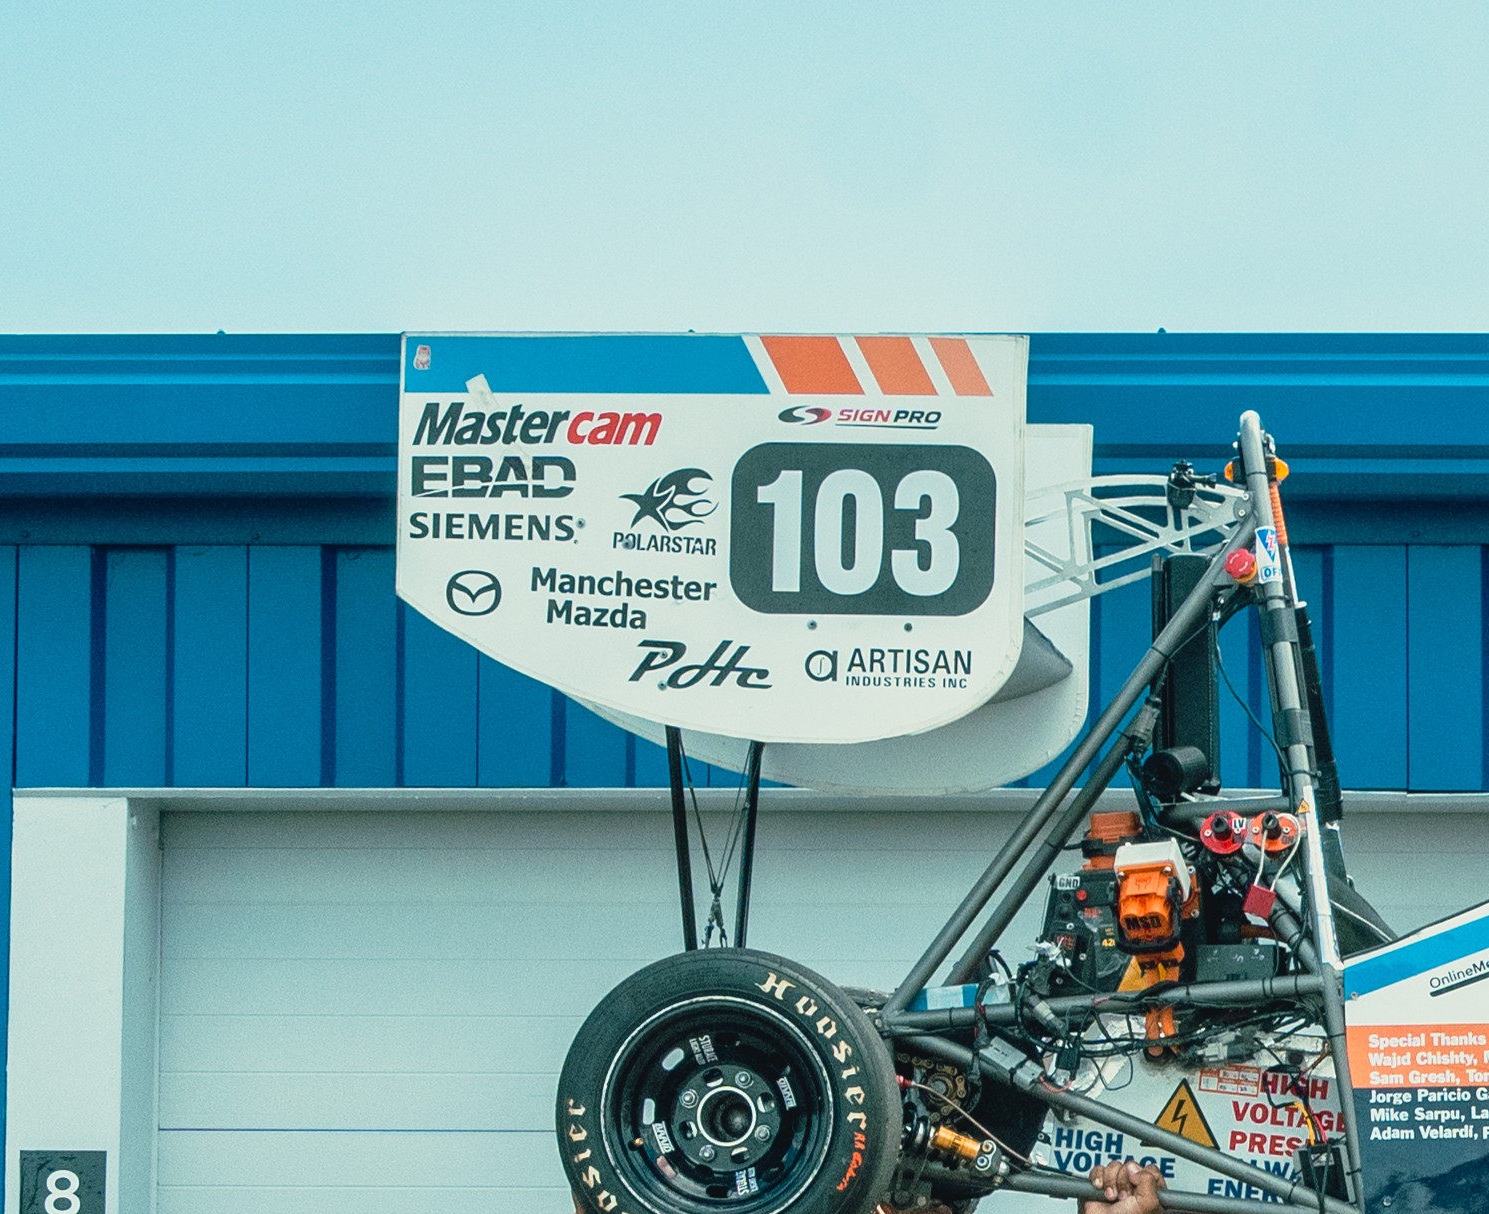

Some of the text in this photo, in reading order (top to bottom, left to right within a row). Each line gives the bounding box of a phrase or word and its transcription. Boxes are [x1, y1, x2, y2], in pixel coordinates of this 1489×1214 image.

[412, 402, 662, 446] Mastercam
[837, 408, 942, 424] SIGN PRO
[411, 456, 577, 498] EBAD
[410, 512, 575, 541] SIEMENS
[757, 468, 959, 596] 103
[612, 532, 717, 556] POLARSTAR
[531, 566, 717, 601] Manchester
[546, 599, 647, 630] Mazda
[847, 648, 972, 675] ARTISAN
[846, 676, 968, 689] INDUSTRIES INC
[1124, 915, 1162, 930] MSD
[755, 971, 868, 1131] Hoosier
[1368, 1033, 1426, 1049] Special
[1430, 1032, 1487, 1047] Thanks
[1416, 1051, 1478, 1067] Chishty,
[1369, 1071, 1404, 1085] Sam
[1408, 1070, 1461, 1085] Gresh,
[1369, 1089, 1412, 1105] Jorge
[1417, 1088, 1471, 1103] Paricio
[1370, 1108, 1409, 1122] Mike
[1414, 1107, 1466, 1123] Sarpu,
[1055, 1128, 1123, 1154] HIGH
[1229, 1131, 1304, 1158] PRES
[1370, 1127, 1414, 1141] Adam
[1419, 1125, 1478, 1141] Velardi,
